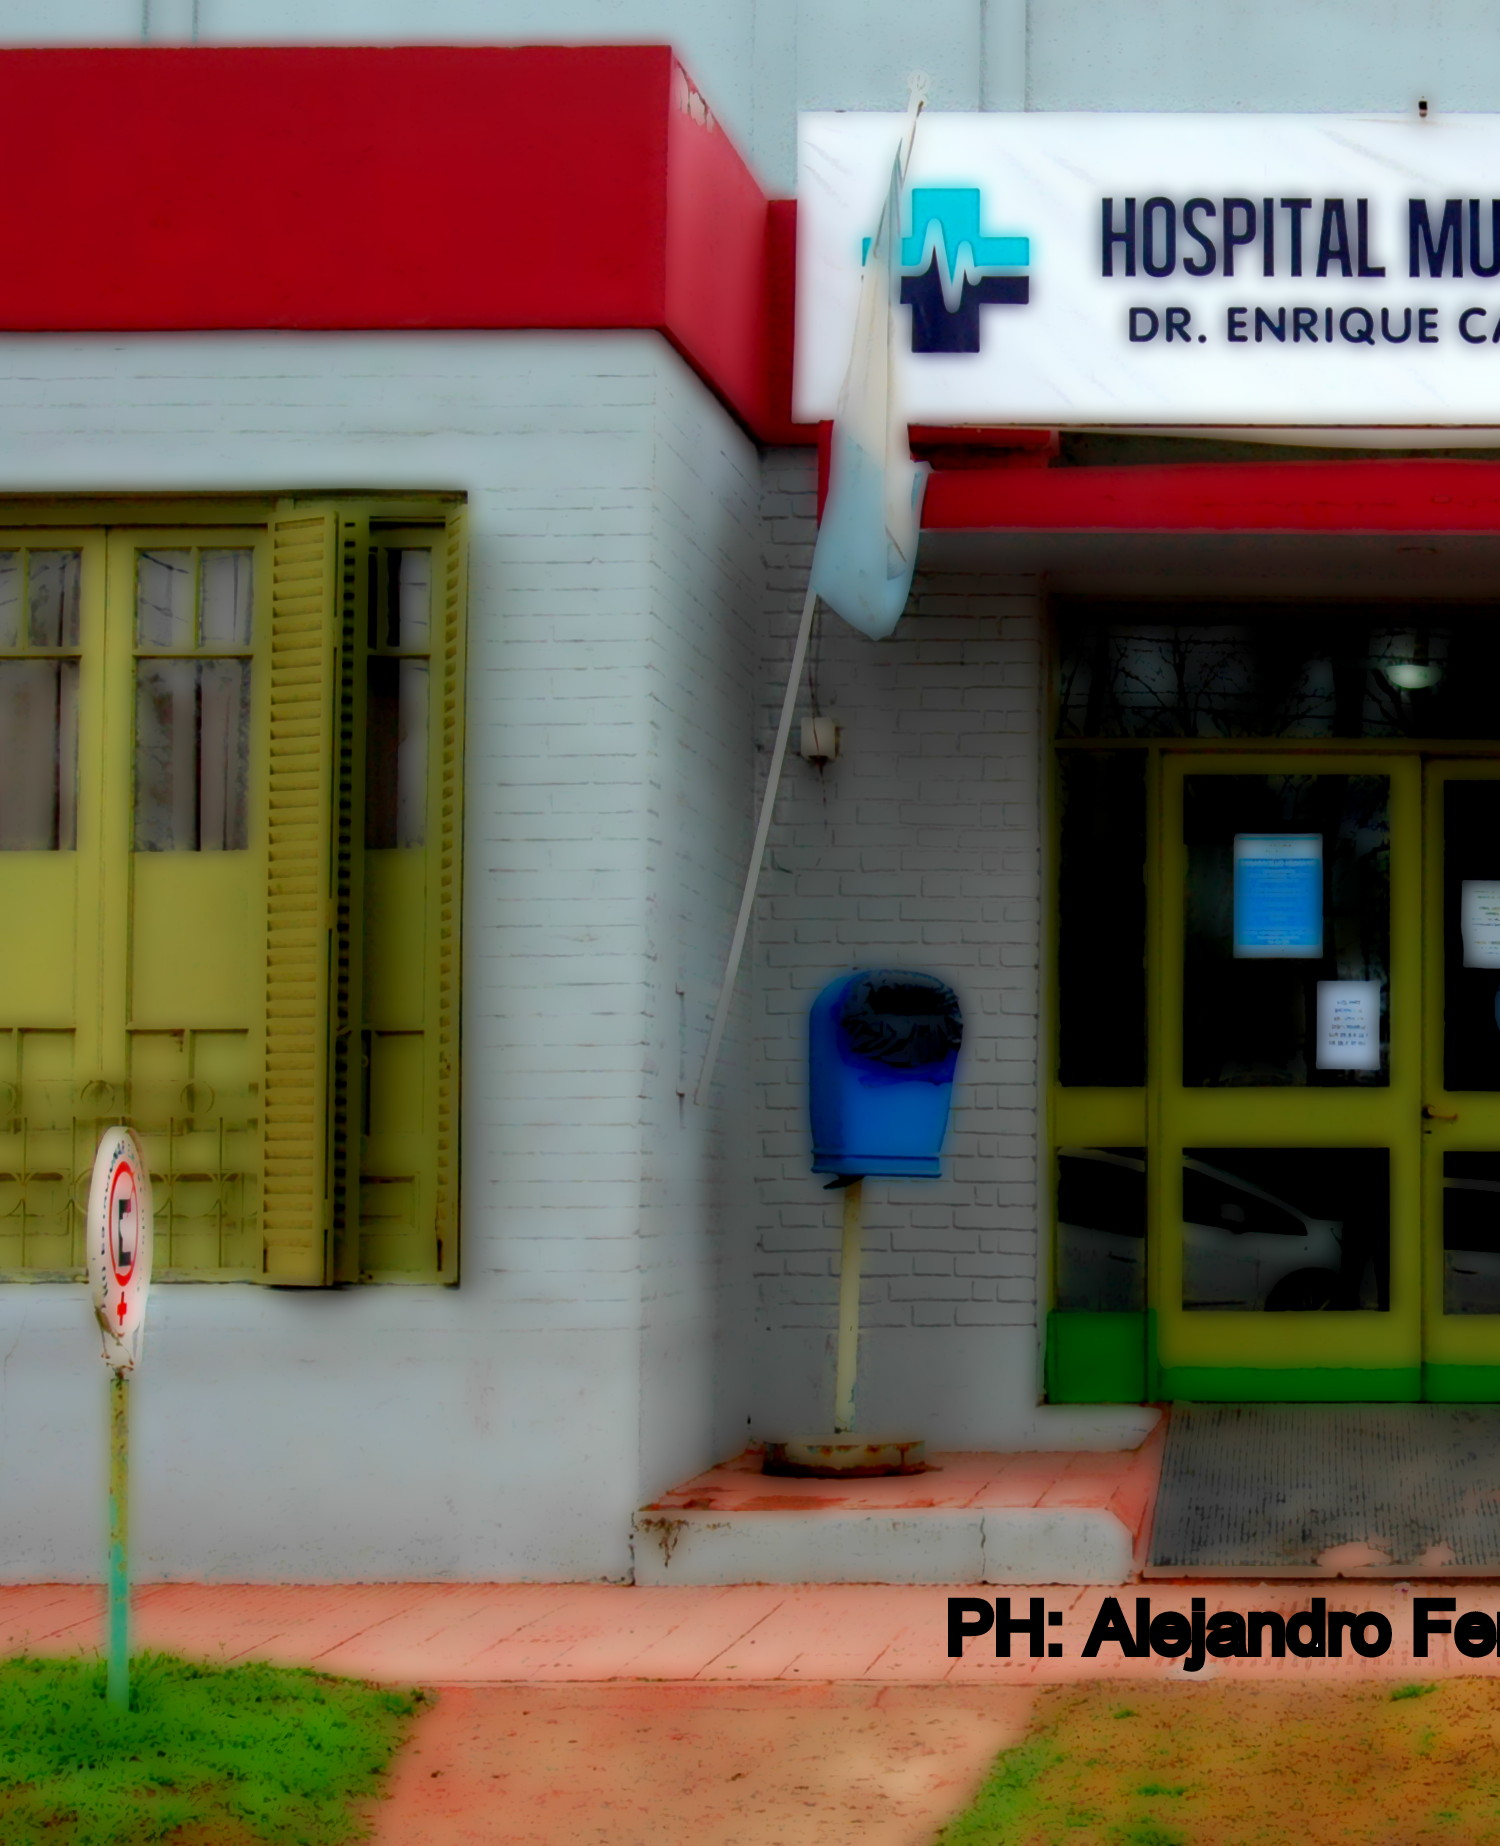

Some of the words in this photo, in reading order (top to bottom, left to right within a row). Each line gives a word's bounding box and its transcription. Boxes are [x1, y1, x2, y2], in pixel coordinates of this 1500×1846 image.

[1101, 196, 1386, 279] HOSPITAL
[1129, 306, 1207, 345] DR.
[1227, 306, 1439, 347] ENRIQUE
